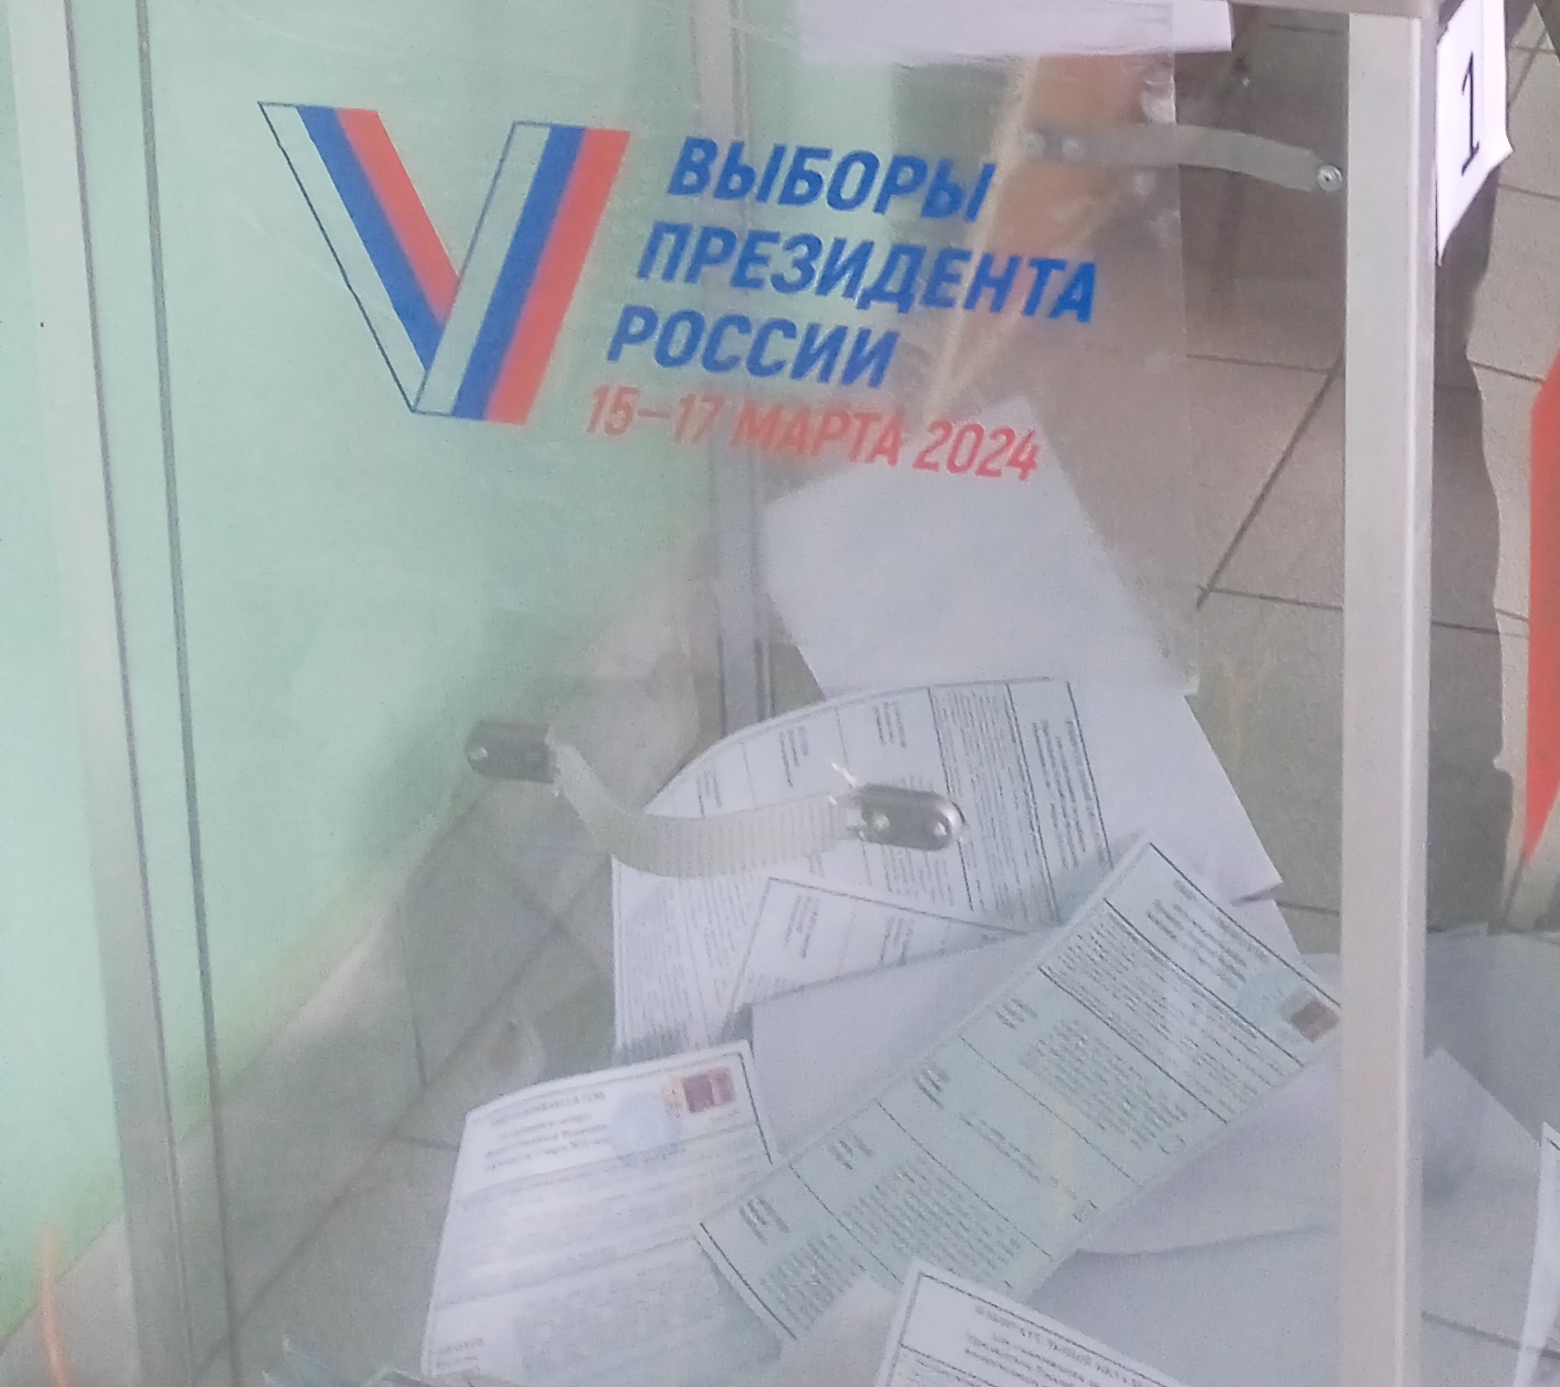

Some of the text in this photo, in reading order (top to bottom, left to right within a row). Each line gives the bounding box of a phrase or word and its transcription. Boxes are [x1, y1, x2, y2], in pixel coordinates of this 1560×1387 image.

[1461, 50, 1480, 177] 1
[667, 135, 997, 223] ВЫБОРЫ
[635, 220, 1097, 324] ПРЕЗИДЕНТА
[606, 304, 901, 389] РОССИИ
[730, 398, 904, 468] МАРТА
[911, 420, 1040, 483] 2024
